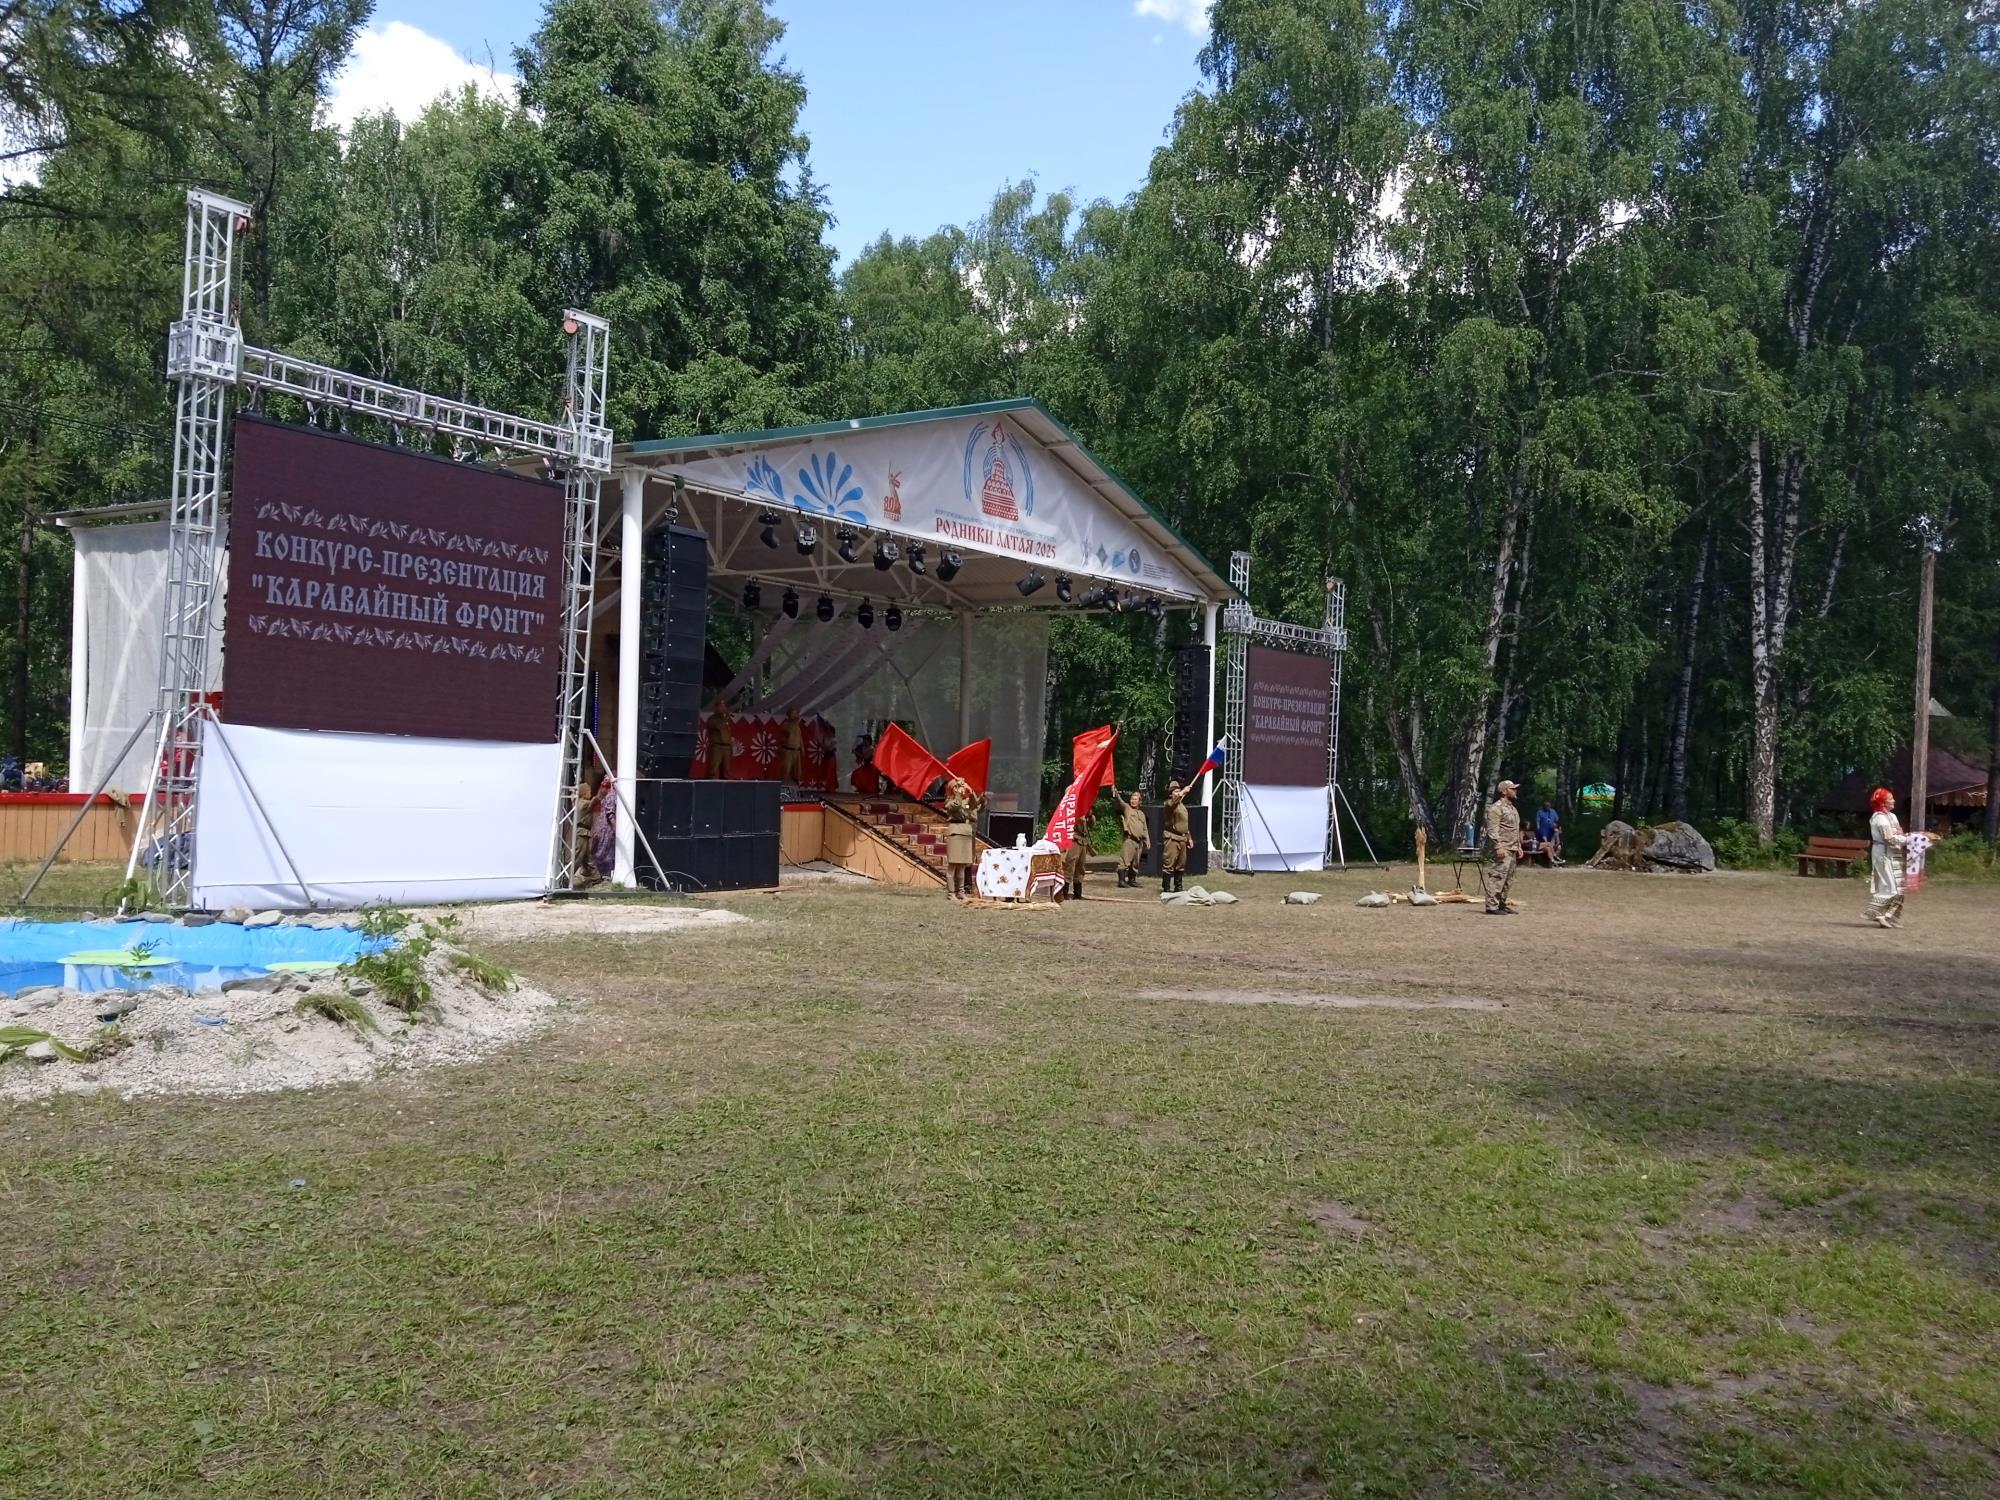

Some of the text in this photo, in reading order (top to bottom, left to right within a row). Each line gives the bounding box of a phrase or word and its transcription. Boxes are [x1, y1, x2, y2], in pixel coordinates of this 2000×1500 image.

[936, 517, 993, 544] РОДНИКИ
[997, 532, 1033, 554] АЛТАЯ
[1035, 542, 1056, 559] 2025
[255, 530, 546, 601] КОНКУРС-ПРЕЗЕНТАЦИЯ
[252, 574, 545, 635] "КАРАВАЙНЫЙ ФРОНТ"
[1252, 695, 1326, 715] КОНКУРС-ПРЕЗЕНТАЦИЯ
